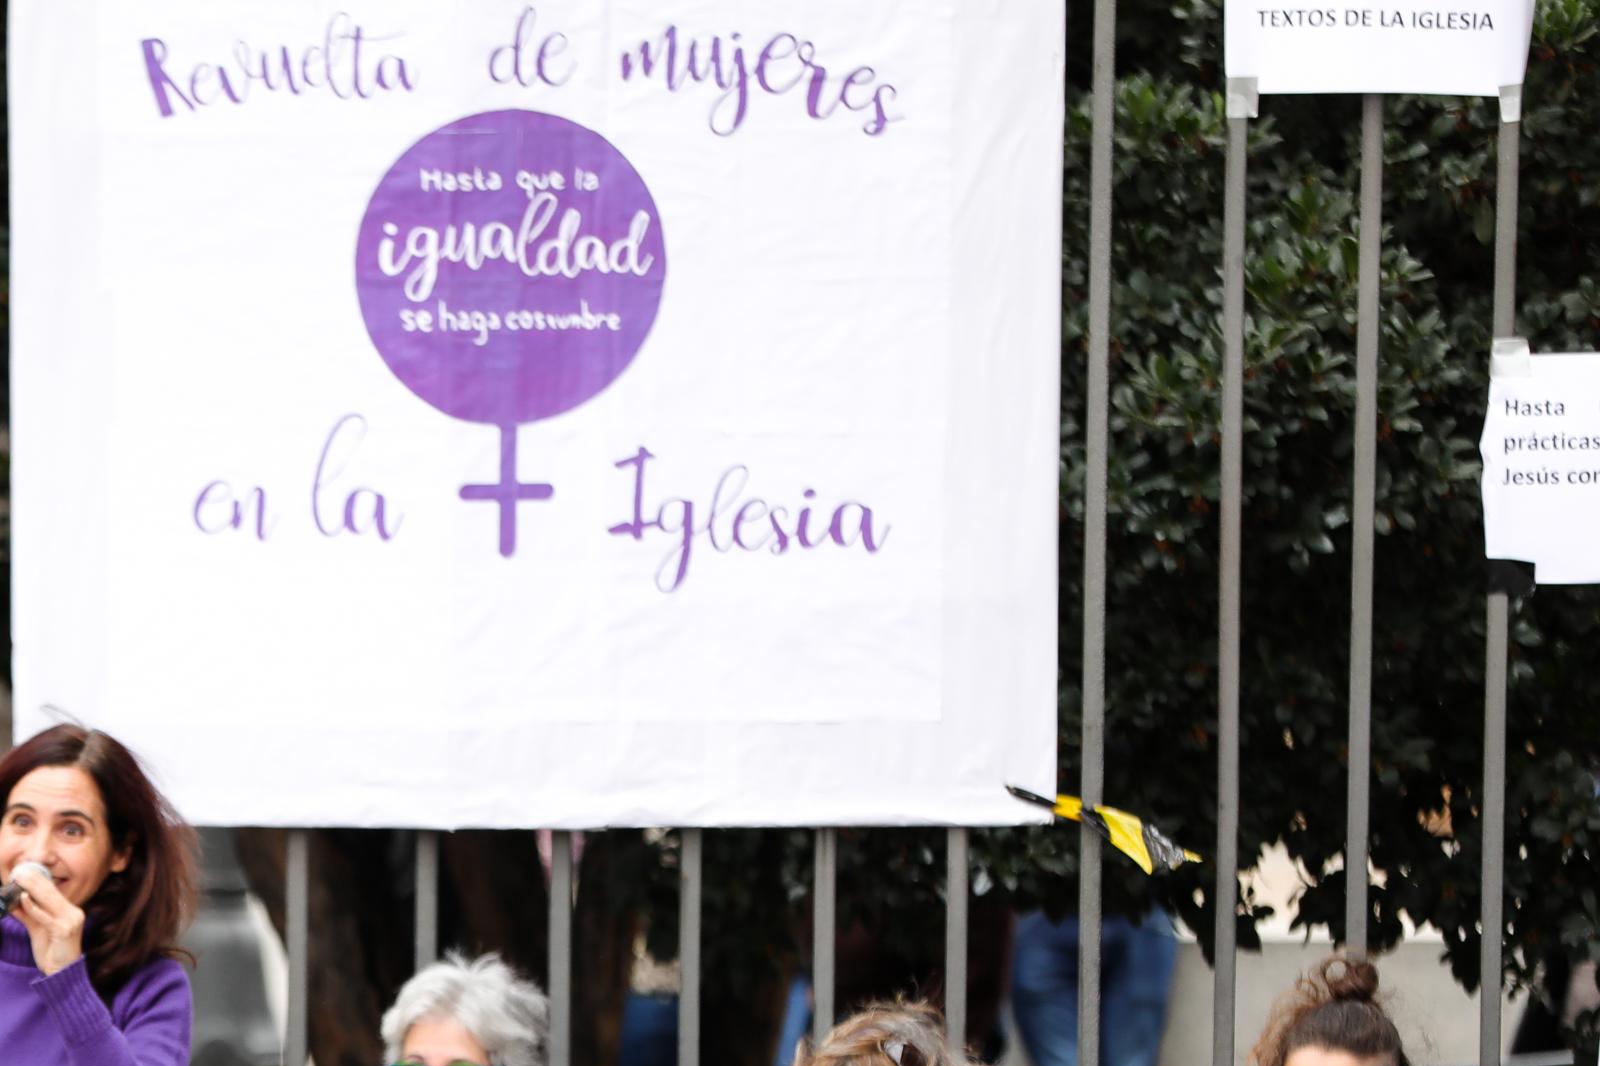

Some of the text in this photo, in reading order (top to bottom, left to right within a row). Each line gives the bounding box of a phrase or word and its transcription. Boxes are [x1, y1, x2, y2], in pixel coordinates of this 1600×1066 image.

[1257, 9, 1494, 30] TEXTOS DE LA IGLESIA
[141, 6, 900, 136] Revuelta de mujeres
[420, 167, 599, 200] Hasta que la
[378, 192, 654, 302] igualdad
[399, 309, 434, 333] se
[438, 299, 501, 346] haga
[1504, 398, 1565, 416] Hasta
[1504, 431, 1600, 455] prácticas
[1503, 466, 1560, 486] Jesús
[194, 413, 891, 593] en la Iglesia
